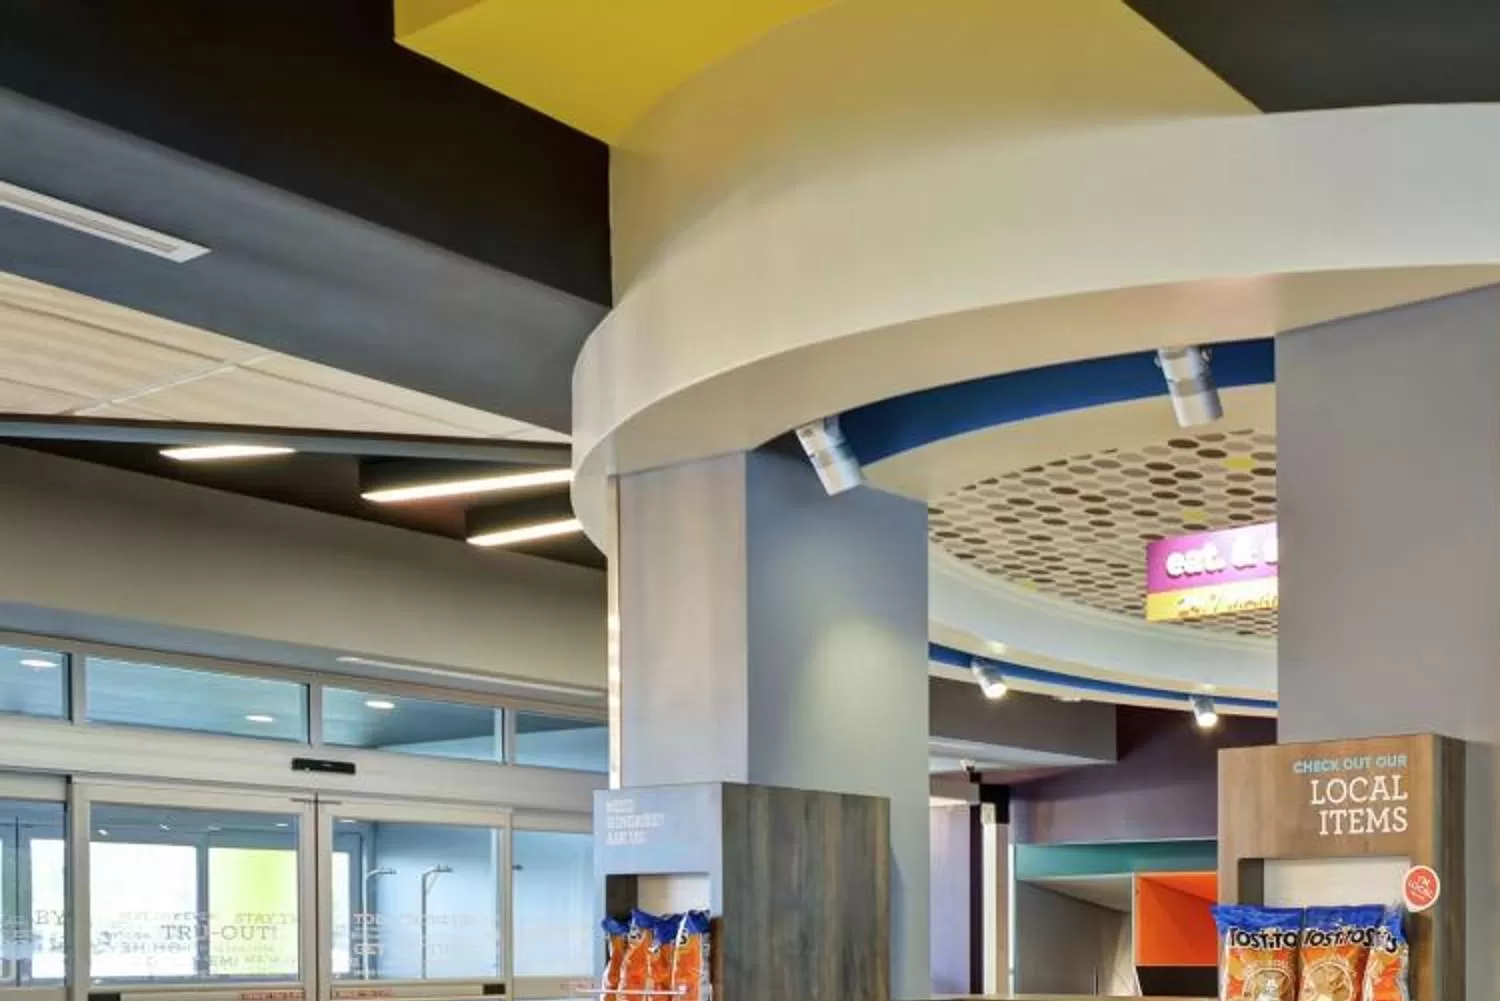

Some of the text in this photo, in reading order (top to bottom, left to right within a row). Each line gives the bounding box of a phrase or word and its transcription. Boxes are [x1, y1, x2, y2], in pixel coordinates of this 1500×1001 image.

[1293, 754, 1407, 773] CHECK OUT OUR
[1310, 774, 1408, 804] LOCAL
[1319, 806, 1408, 834] ITEMS
[1229, 928, 1299, 948] TOSTITO
